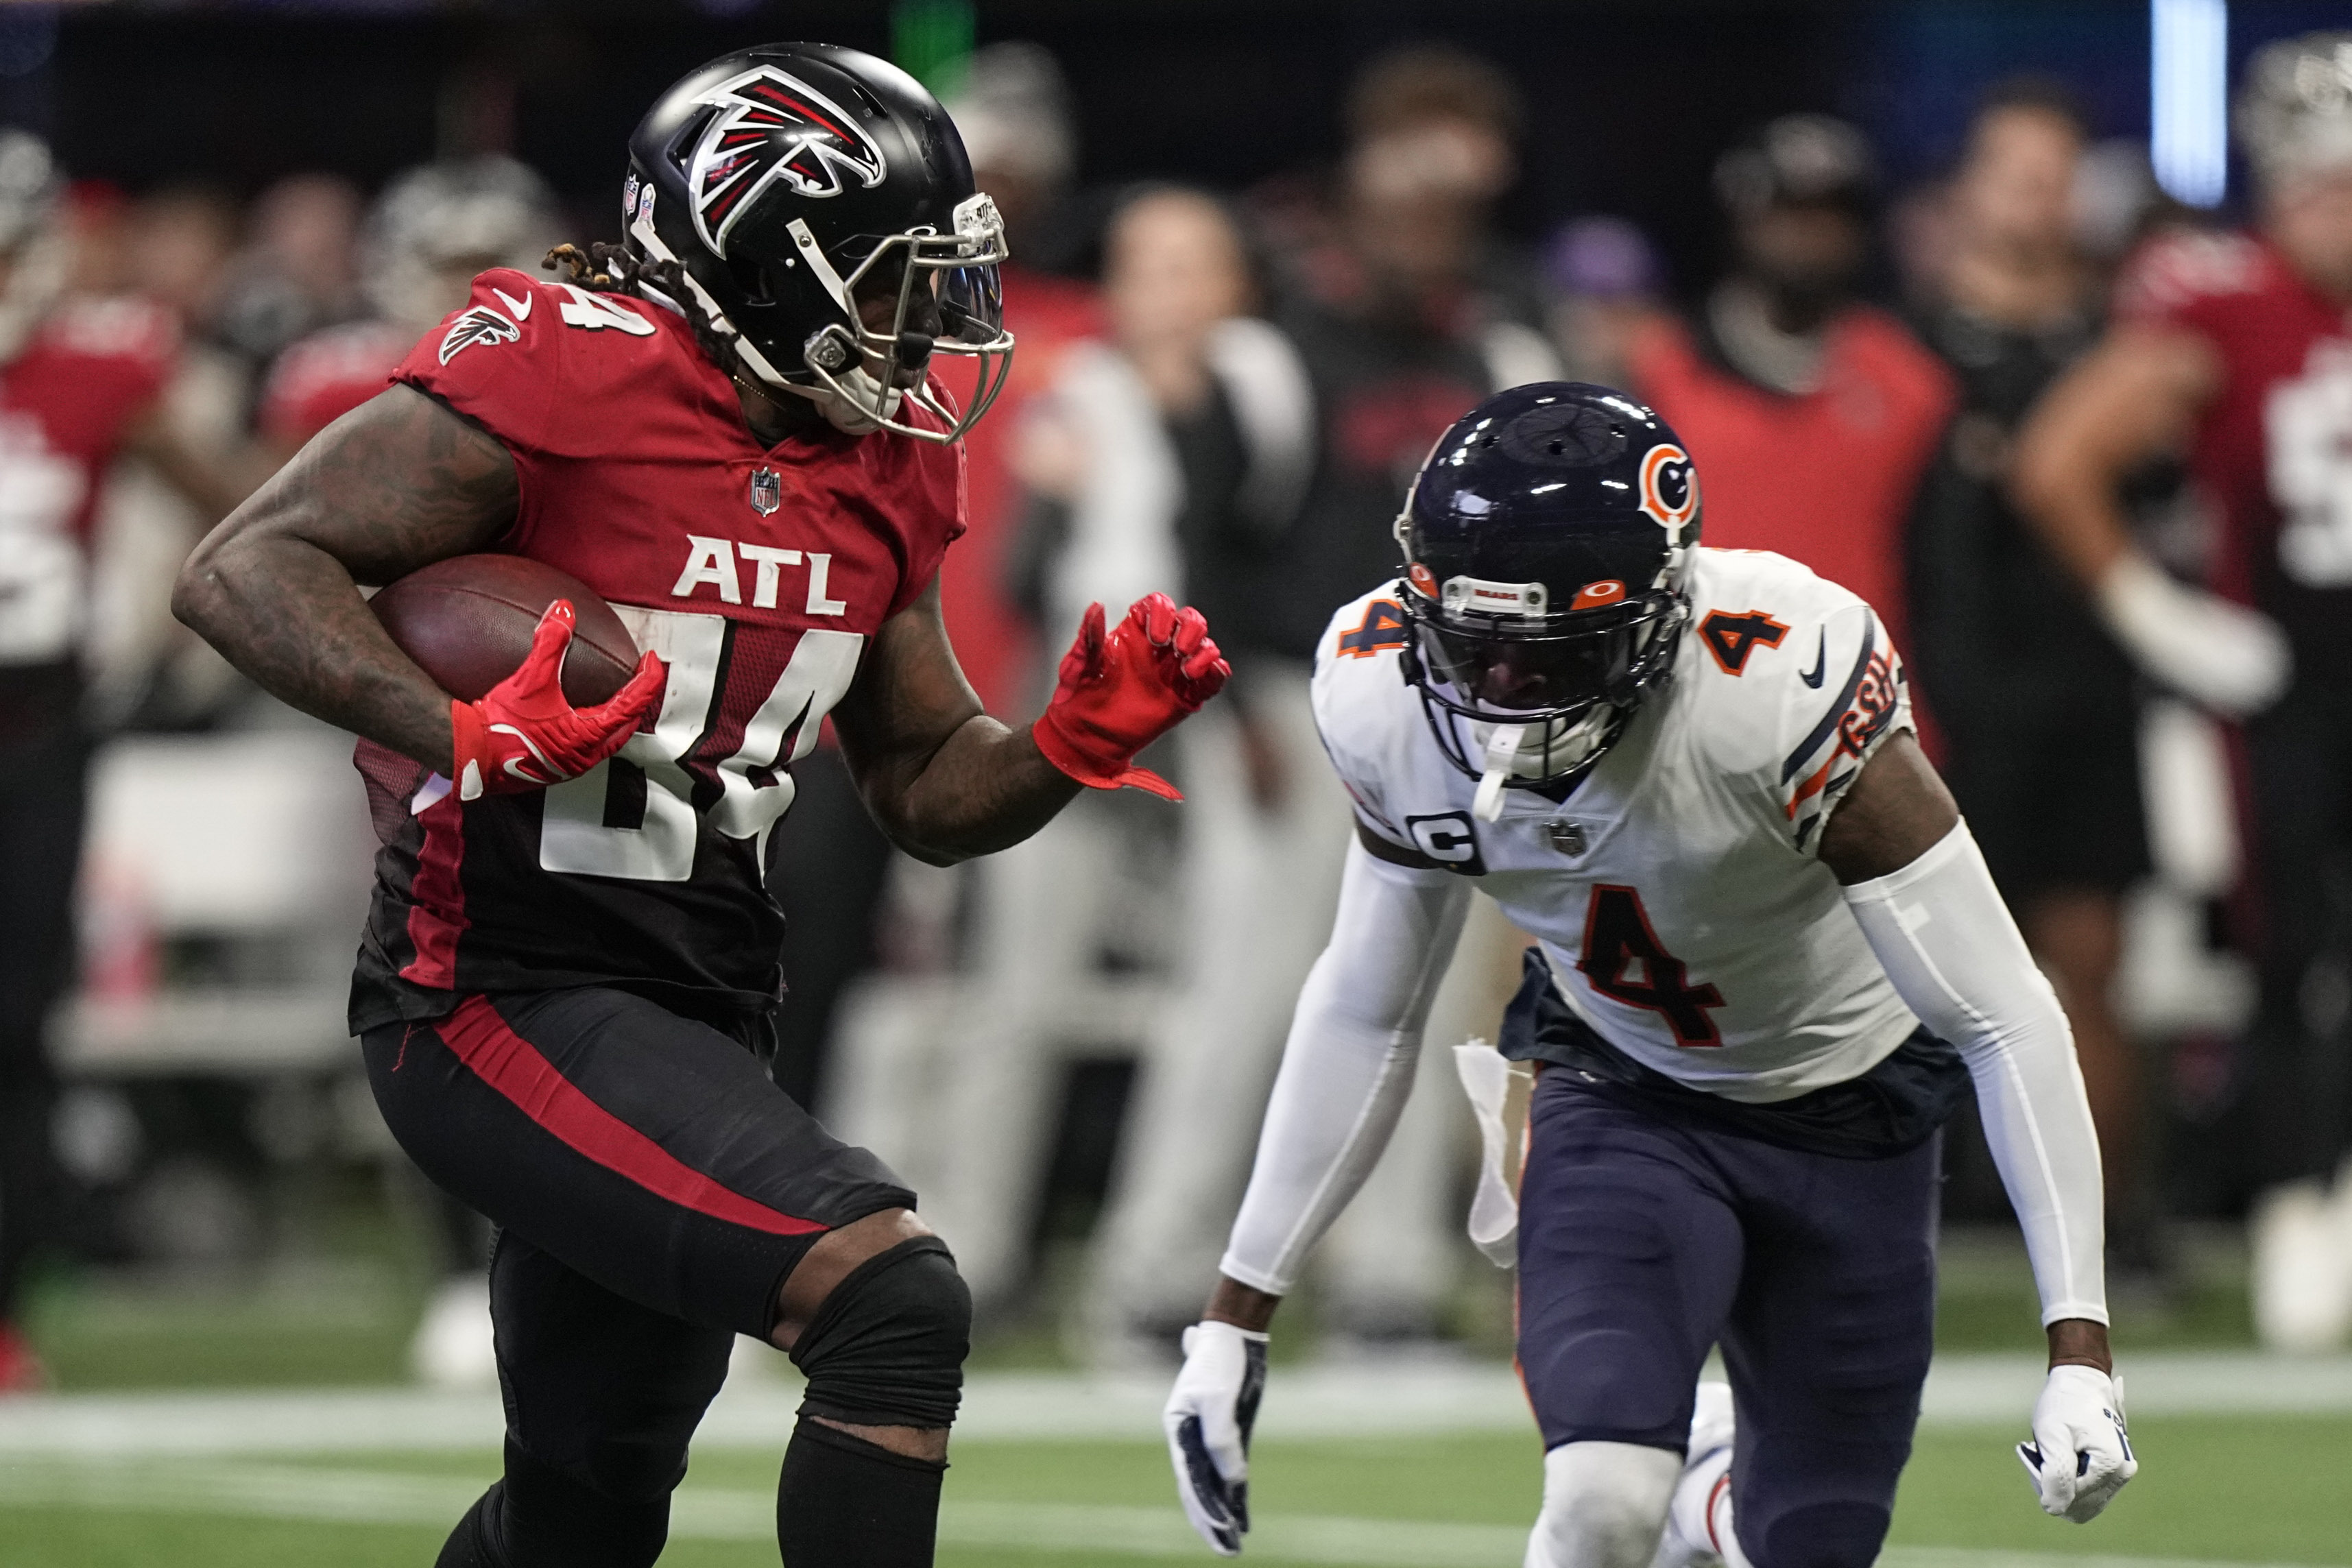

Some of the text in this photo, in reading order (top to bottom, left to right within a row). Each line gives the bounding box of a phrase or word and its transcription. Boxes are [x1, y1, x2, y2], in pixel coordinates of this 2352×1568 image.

[671, 533, 847, 616] ATL
[1336, 599, 1405, 659] 4
[1696, 609, 1792, 677] 4
[1411, 817, 1474, 862] C
[1575, 883, 1727, 1047] 4
